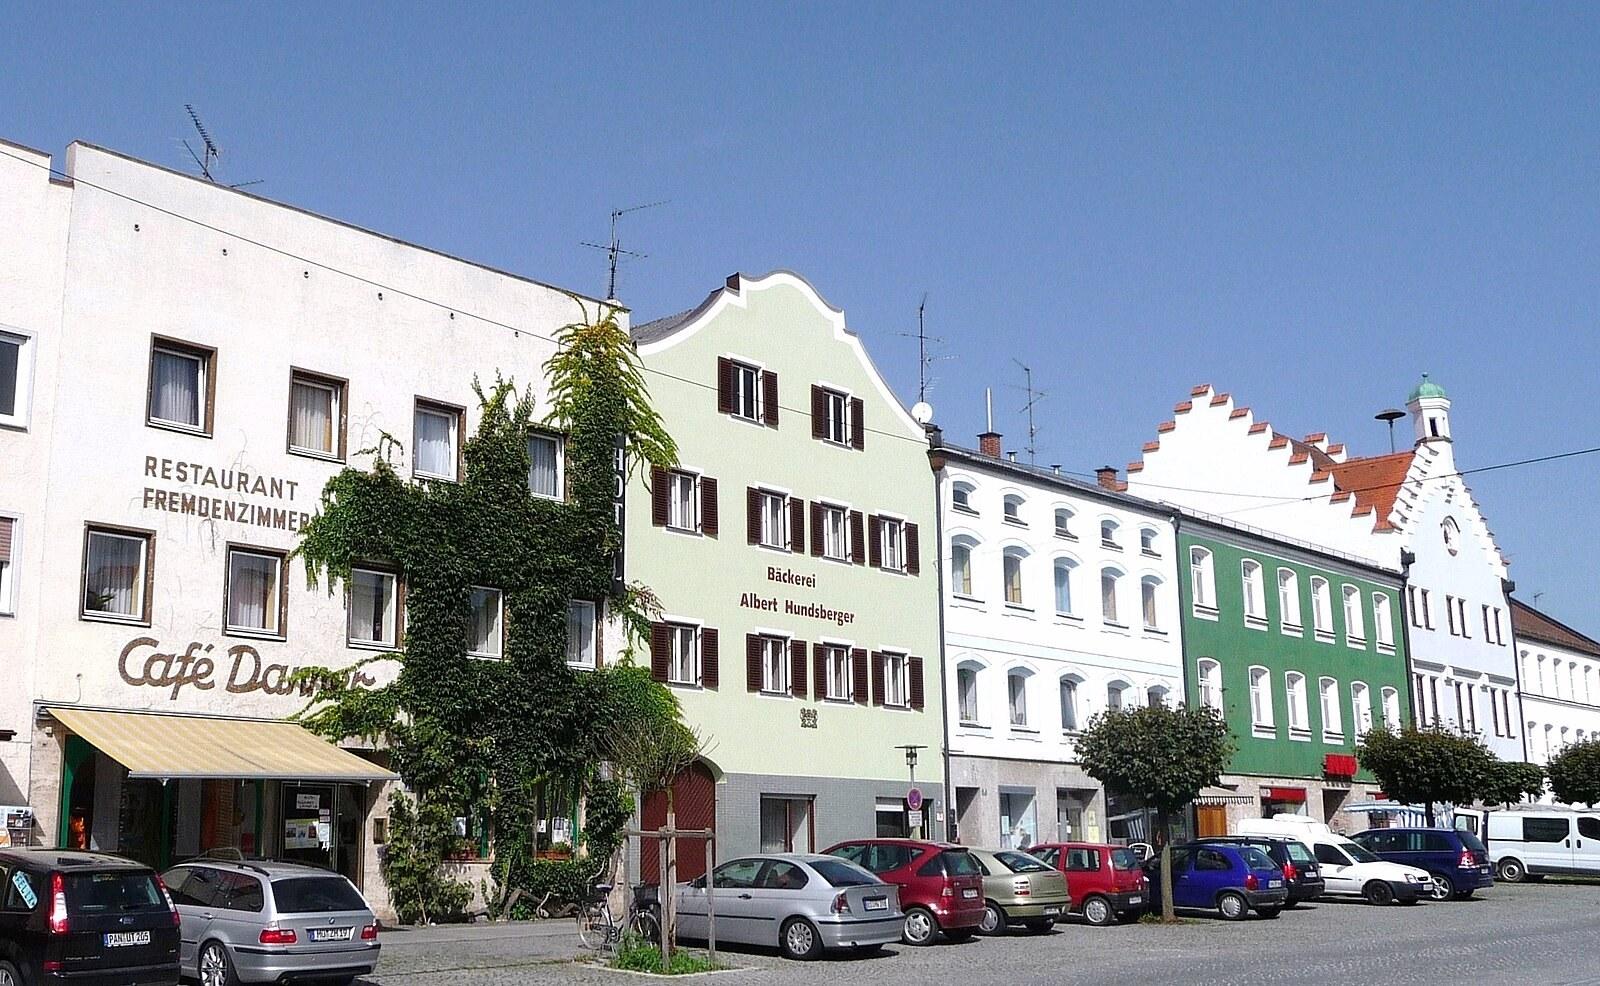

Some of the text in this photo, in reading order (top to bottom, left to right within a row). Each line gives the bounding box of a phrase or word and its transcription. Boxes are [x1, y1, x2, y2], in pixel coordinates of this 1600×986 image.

[144, 455, 299, 501] RESTAURANT
[613, 447, 623, 581] HOTL
[767, 566, 816, 588] Bäckerei
[740, 592, 855, 626] Albert Hundsberger
[118, 636, 216, 701] Café
